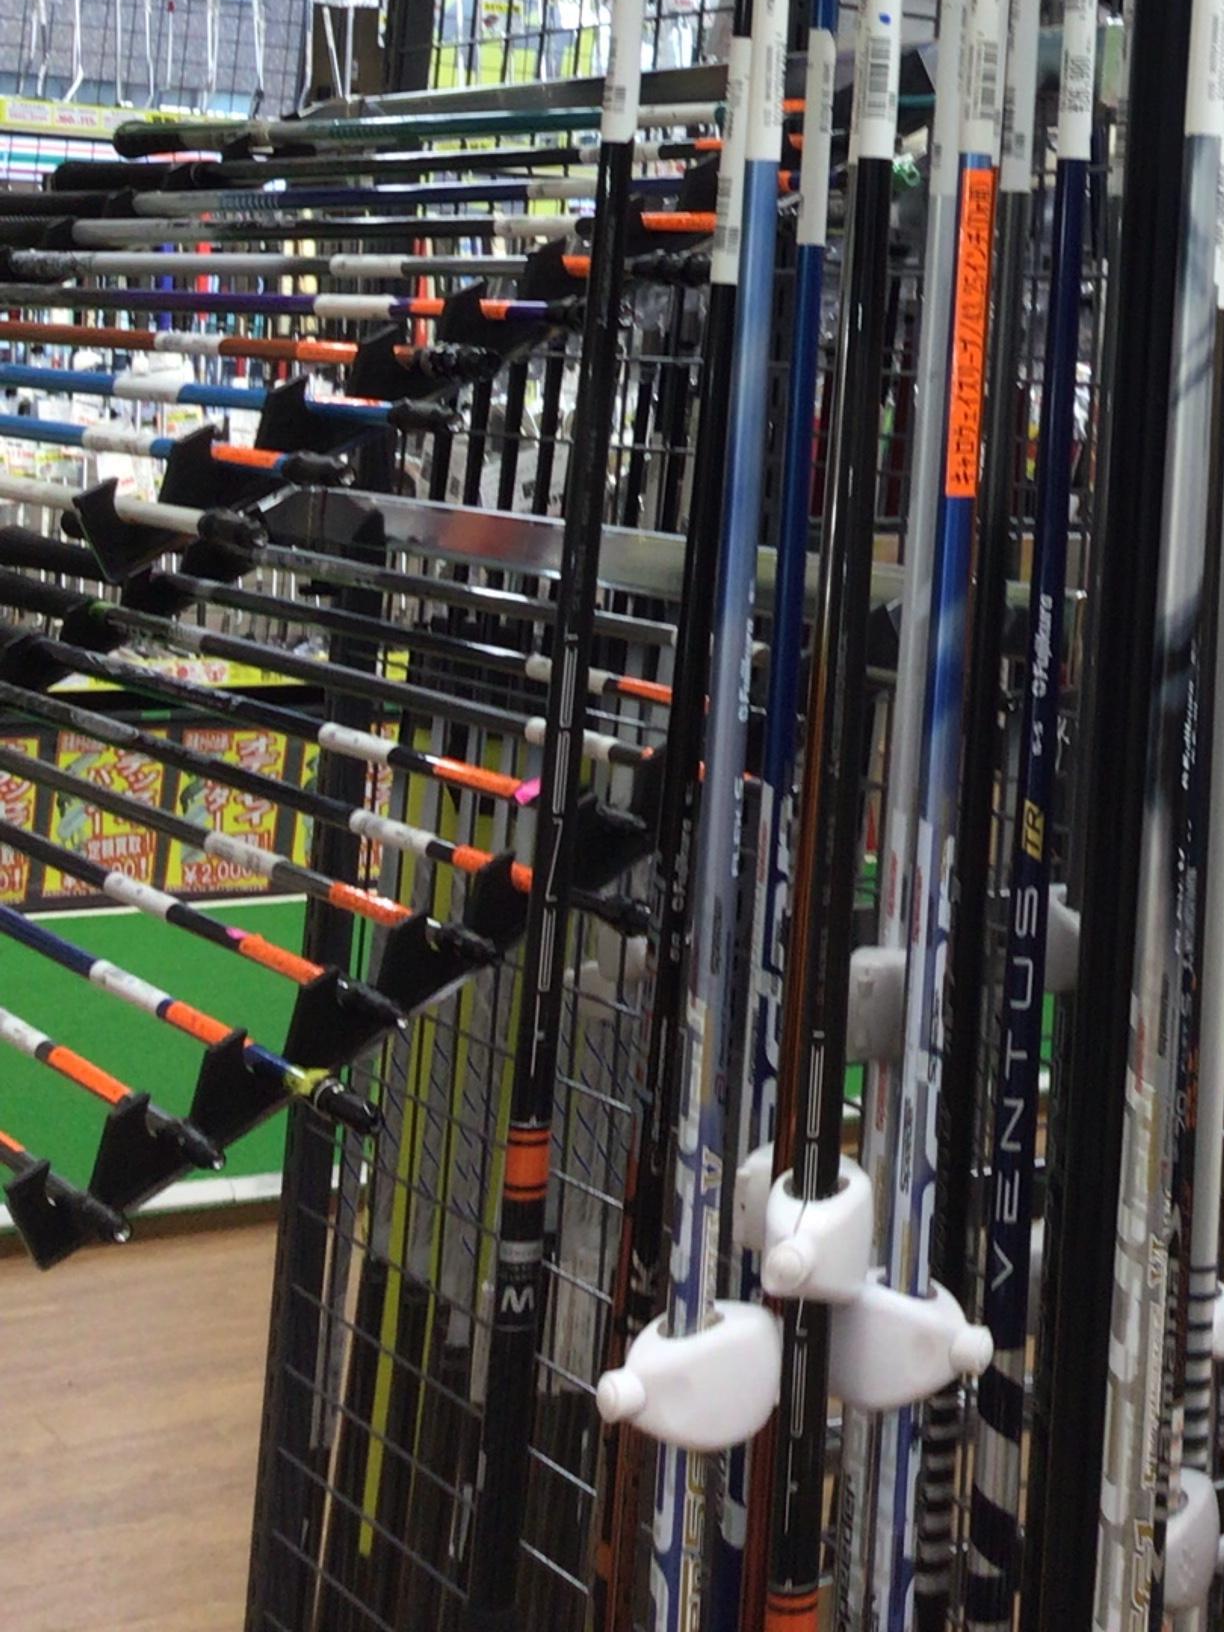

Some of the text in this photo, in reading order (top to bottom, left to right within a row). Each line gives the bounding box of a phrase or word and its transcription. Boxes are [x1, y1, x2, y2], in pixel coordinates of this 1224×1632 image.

[1031, 594, 1053, 680] Fujikura
[991, 799, 1045, 1290] VENTUS TR
